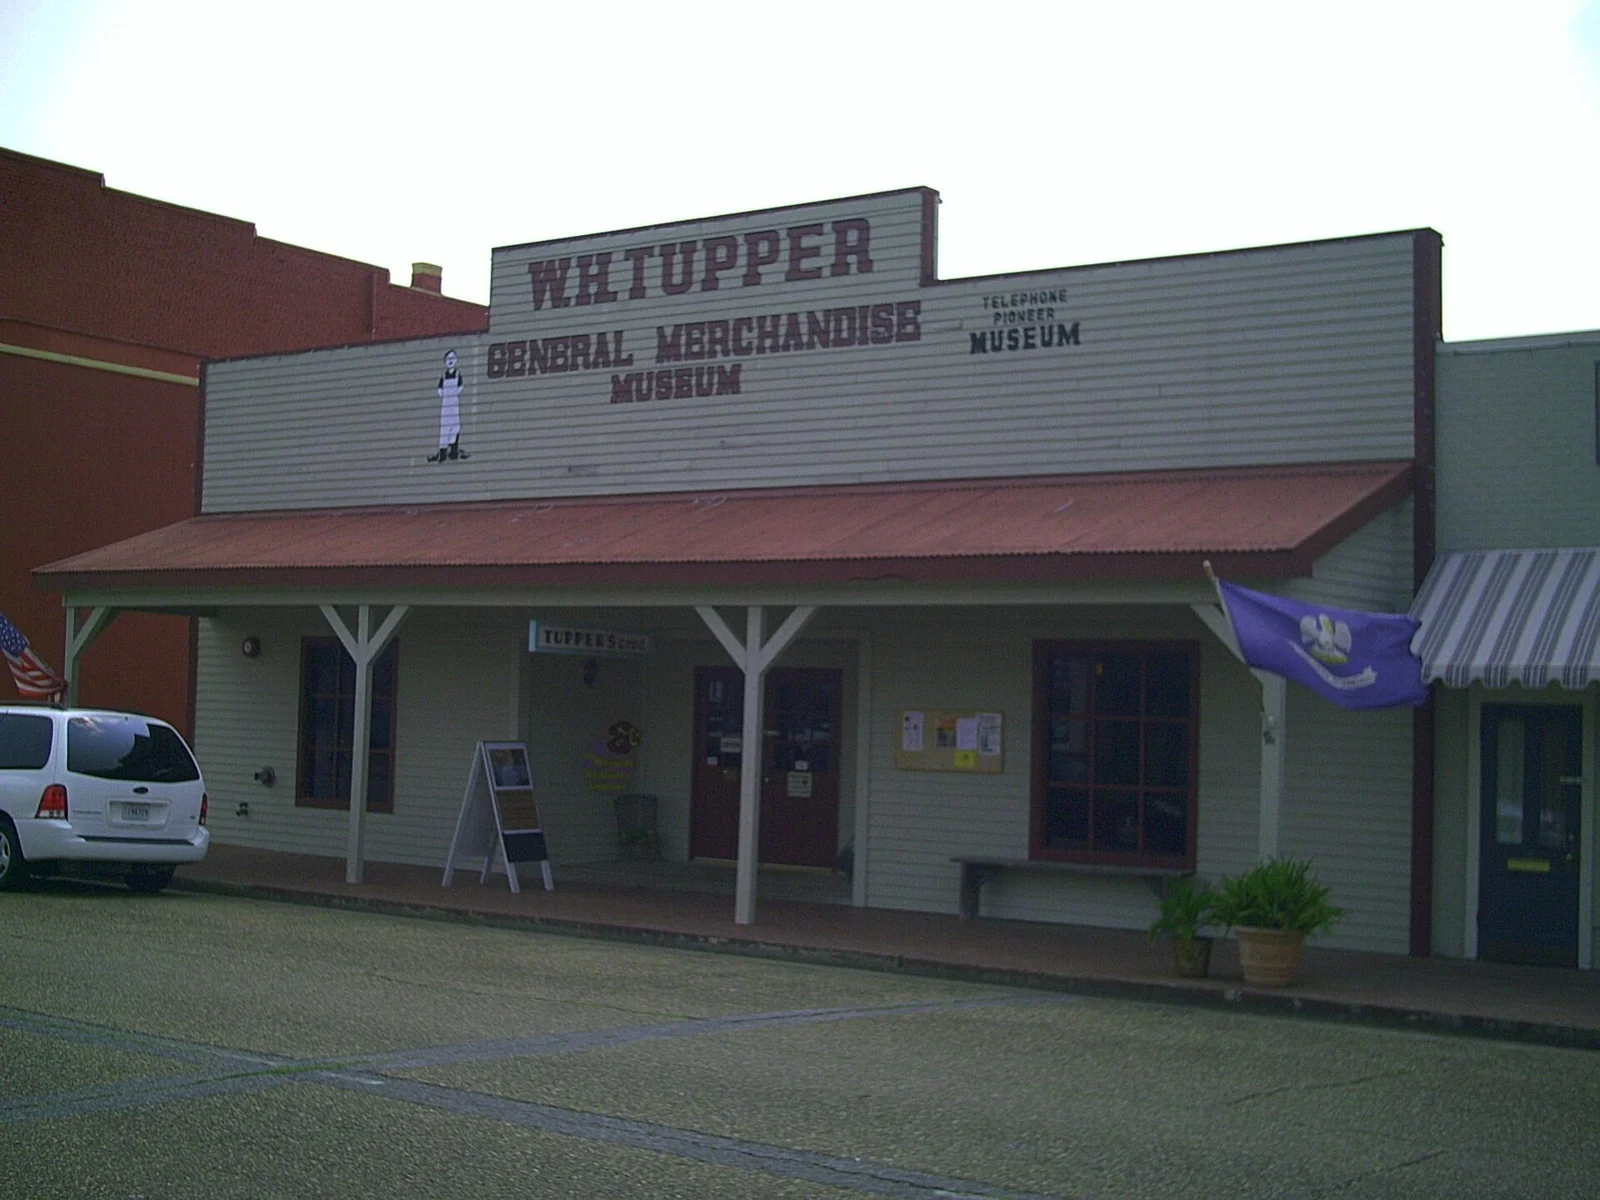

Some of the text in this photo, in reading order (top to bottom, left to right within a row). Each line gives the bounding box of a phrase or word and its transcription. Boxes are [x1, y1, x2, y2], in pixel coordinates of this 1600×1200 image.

[625, 218, 873, 299] TUPPER
[983, 289, 1068, 309] TELEPHONE
[993, 308, 1056, 325] PIONEER
[488, 301, 921, 379] GENERAL MERCHANDISE
[970, 322, 1080, 354] MUSEUM
[610, 363, 742, 403] MUSEUM
